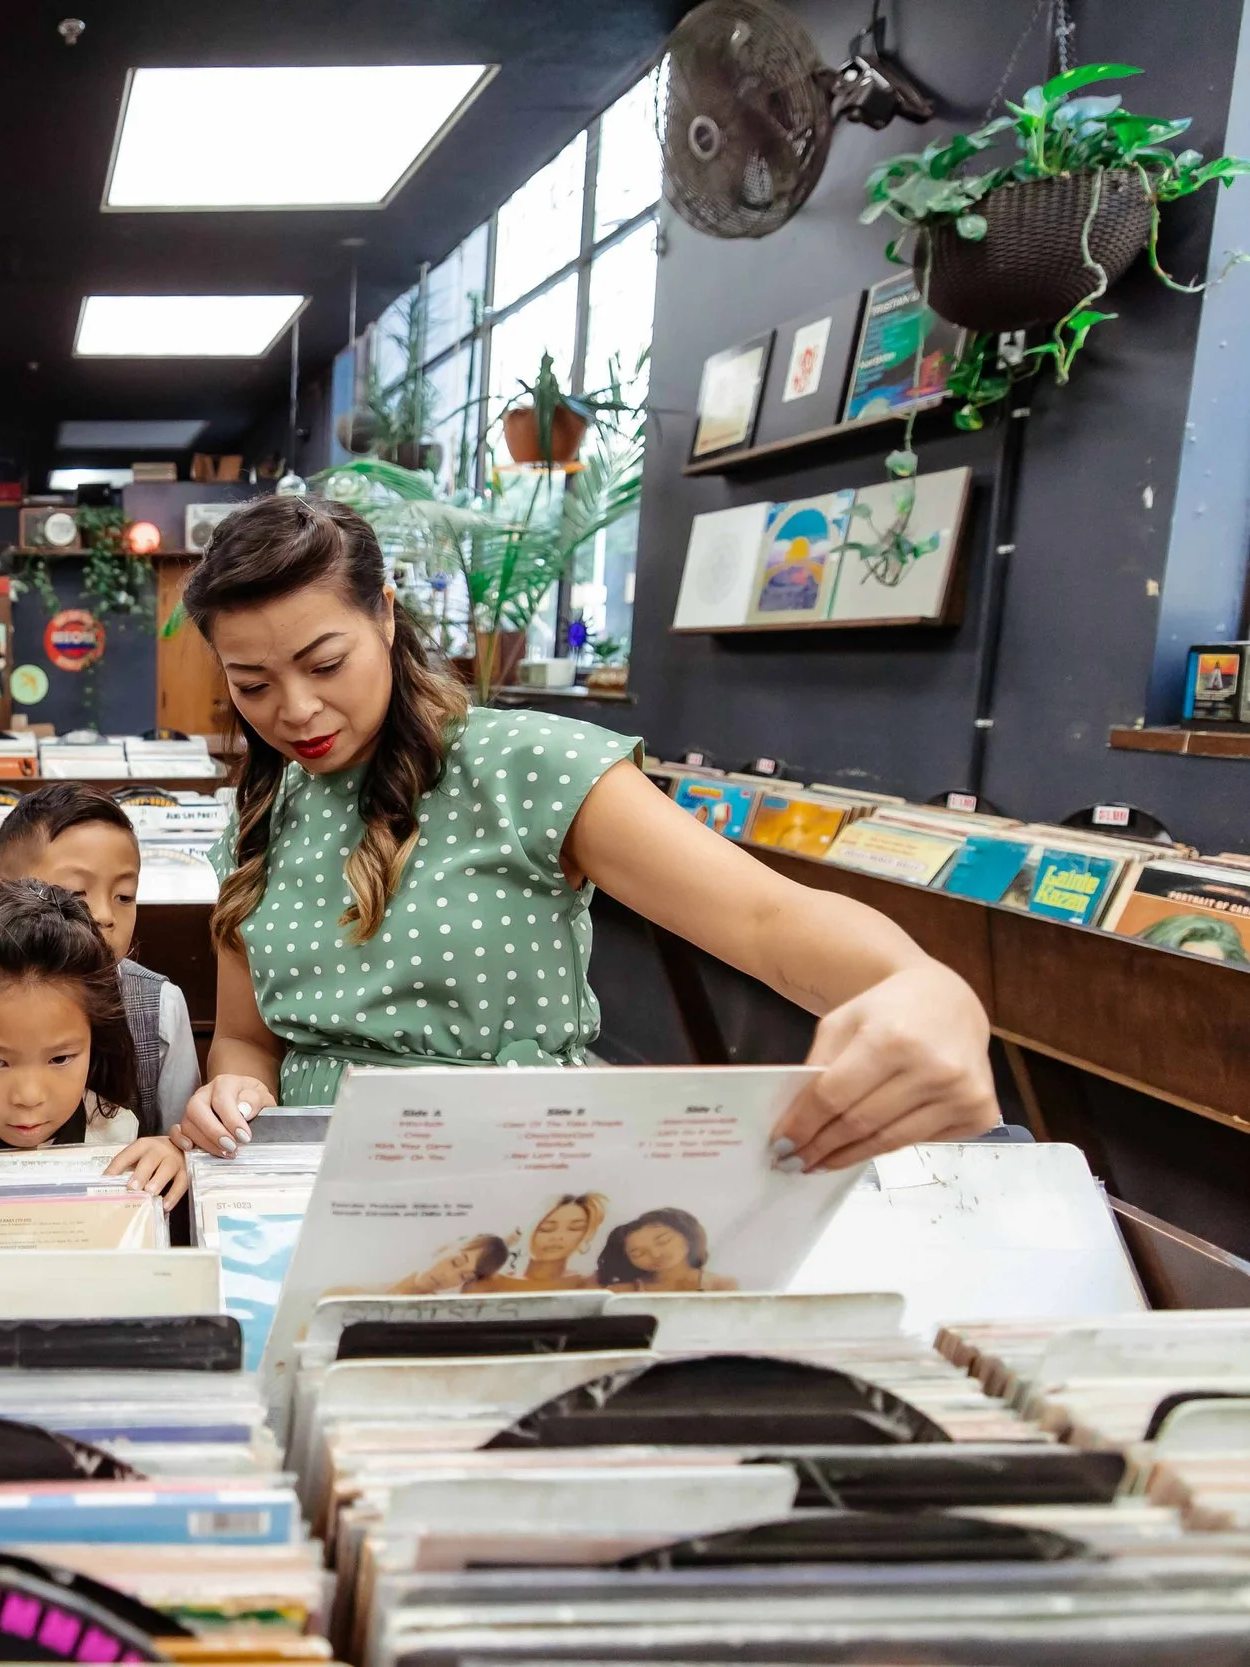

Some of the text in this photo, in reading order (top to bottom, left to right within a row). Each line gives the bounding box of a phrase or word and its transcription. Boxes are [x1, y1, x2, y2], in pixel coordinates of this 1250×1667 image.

[1168, 890, 1215, 908] PORTRAIT
[1214, 900, 1230, 911] OF
[216, 1201, 252, 1210] ST-1023
